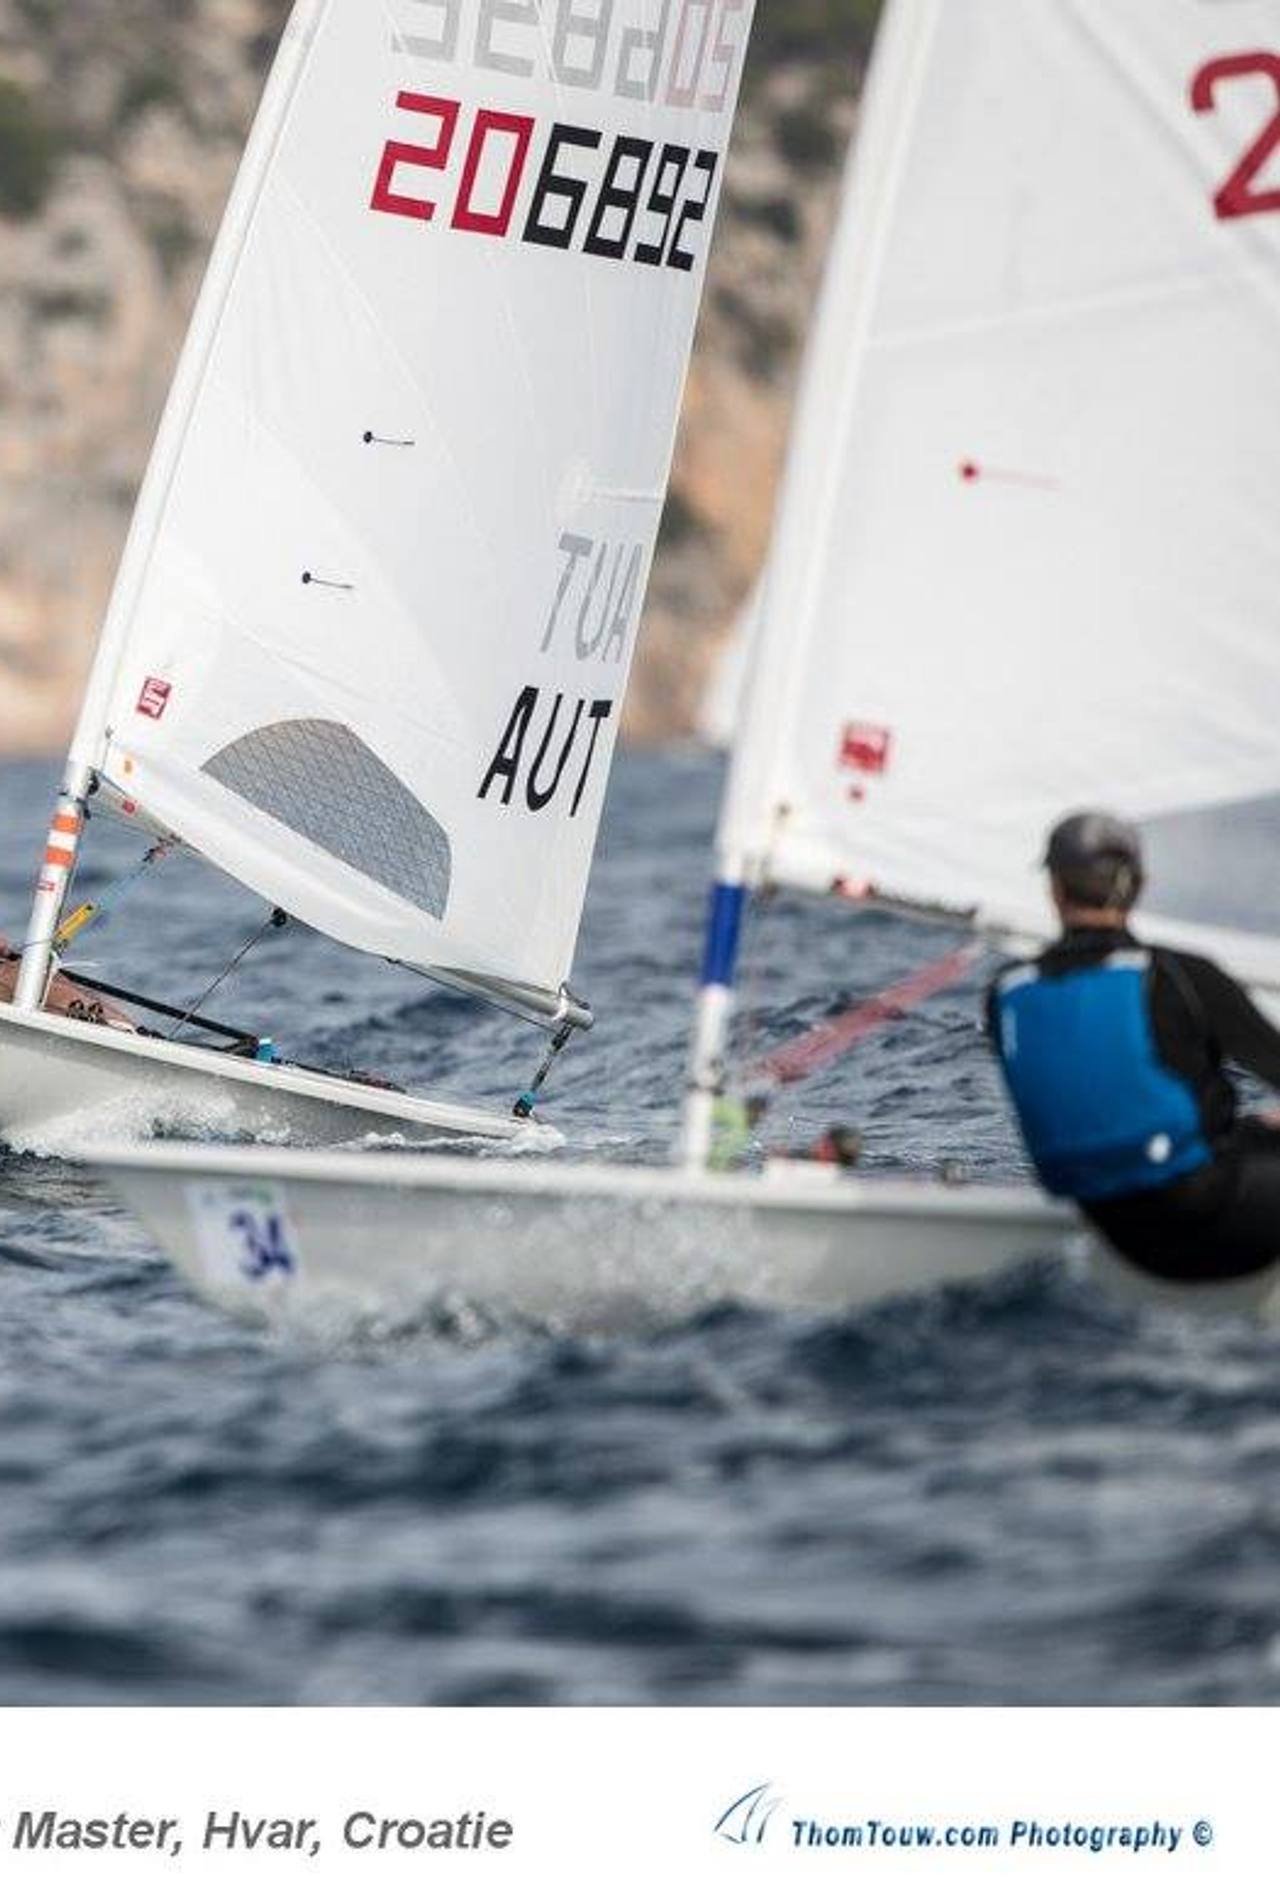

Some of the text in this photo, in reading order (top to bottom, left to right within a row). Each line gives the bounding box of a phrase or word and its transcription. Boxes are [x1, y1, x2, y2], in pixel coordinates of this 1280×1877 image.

[370, 90, 718, 271] 206892
[477, 685, 613, 817] AUT
[228, 1211, 294, 1279] 34
